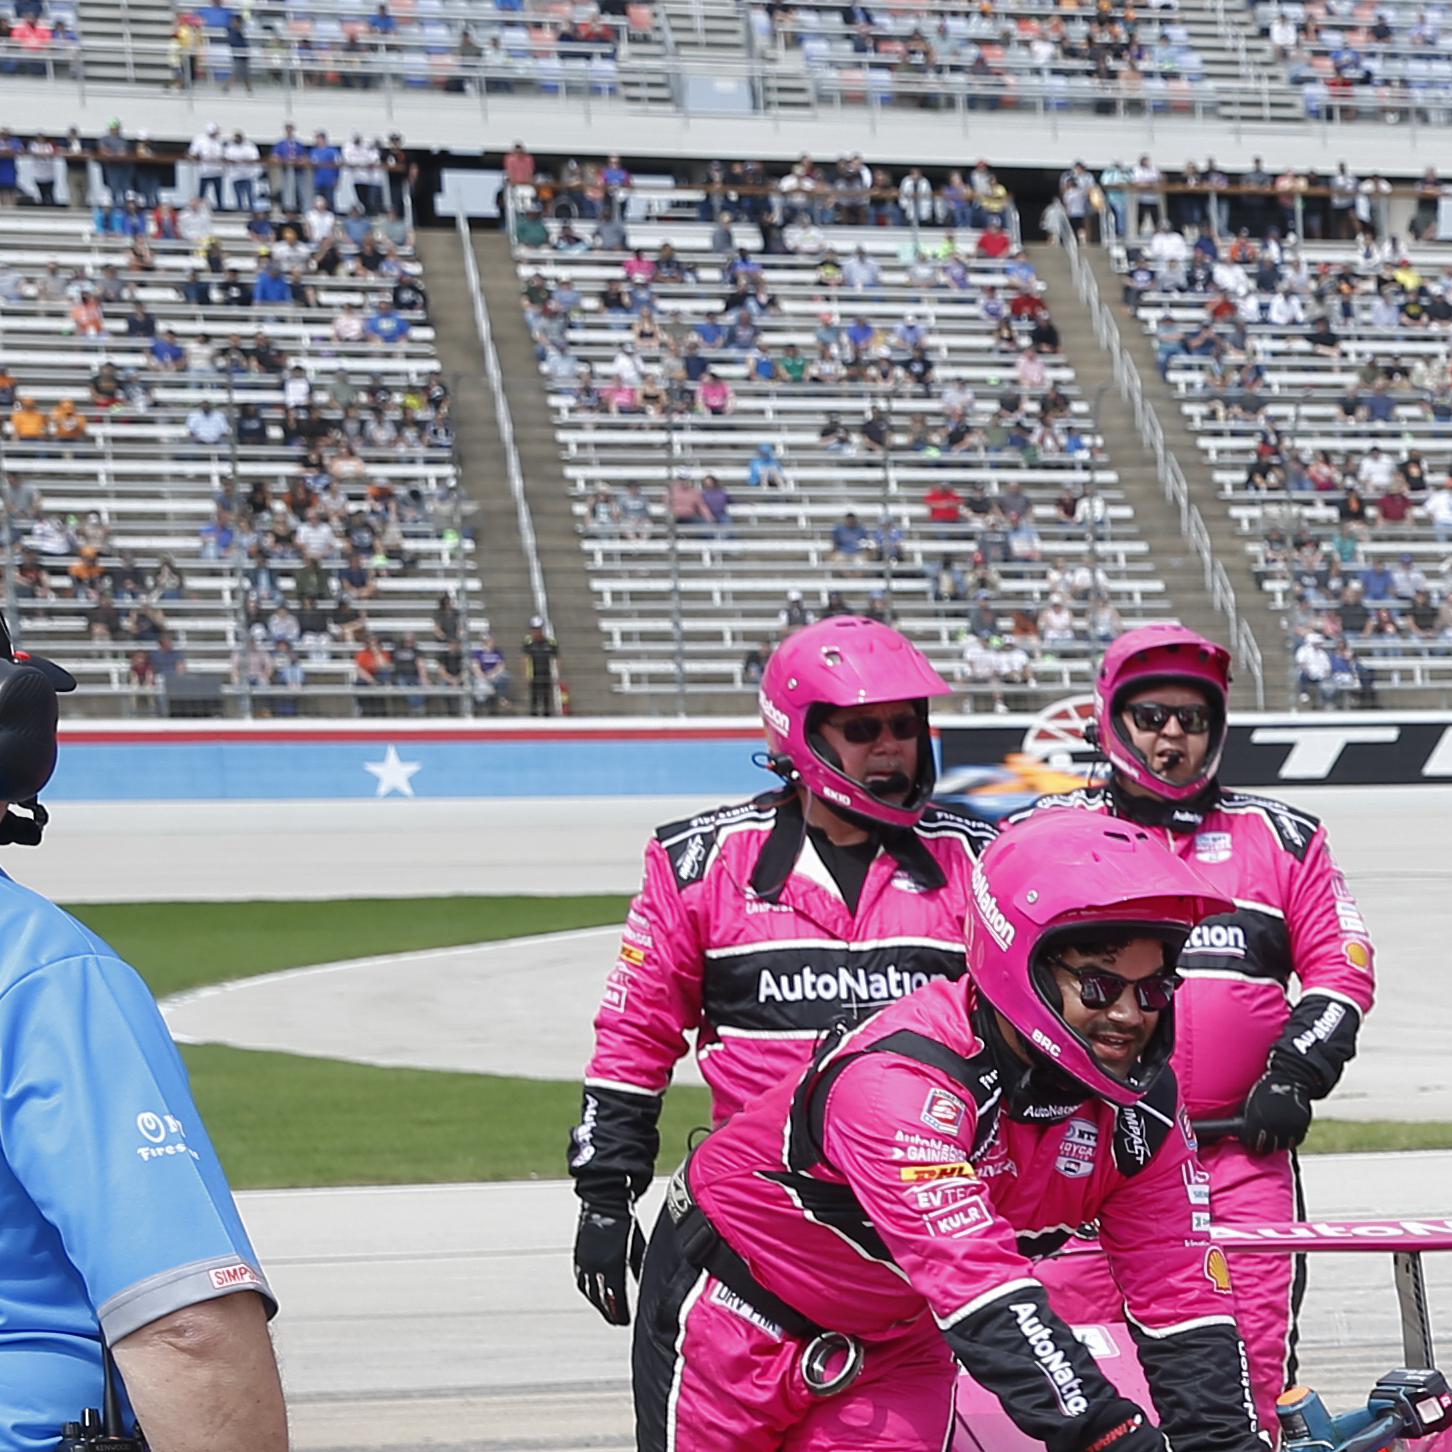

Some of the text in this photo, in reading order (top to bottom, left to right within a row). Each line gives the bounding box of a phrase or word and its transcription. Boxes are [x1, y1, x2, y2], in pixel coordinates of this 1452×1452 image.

[1032, 1028, 1061, 1058] BRC
[1122, 1107, 1147, 1166] IMPACT
[914, 1166, 969, 1181] DHL
[937, 1206, 982, 1234] KULR
